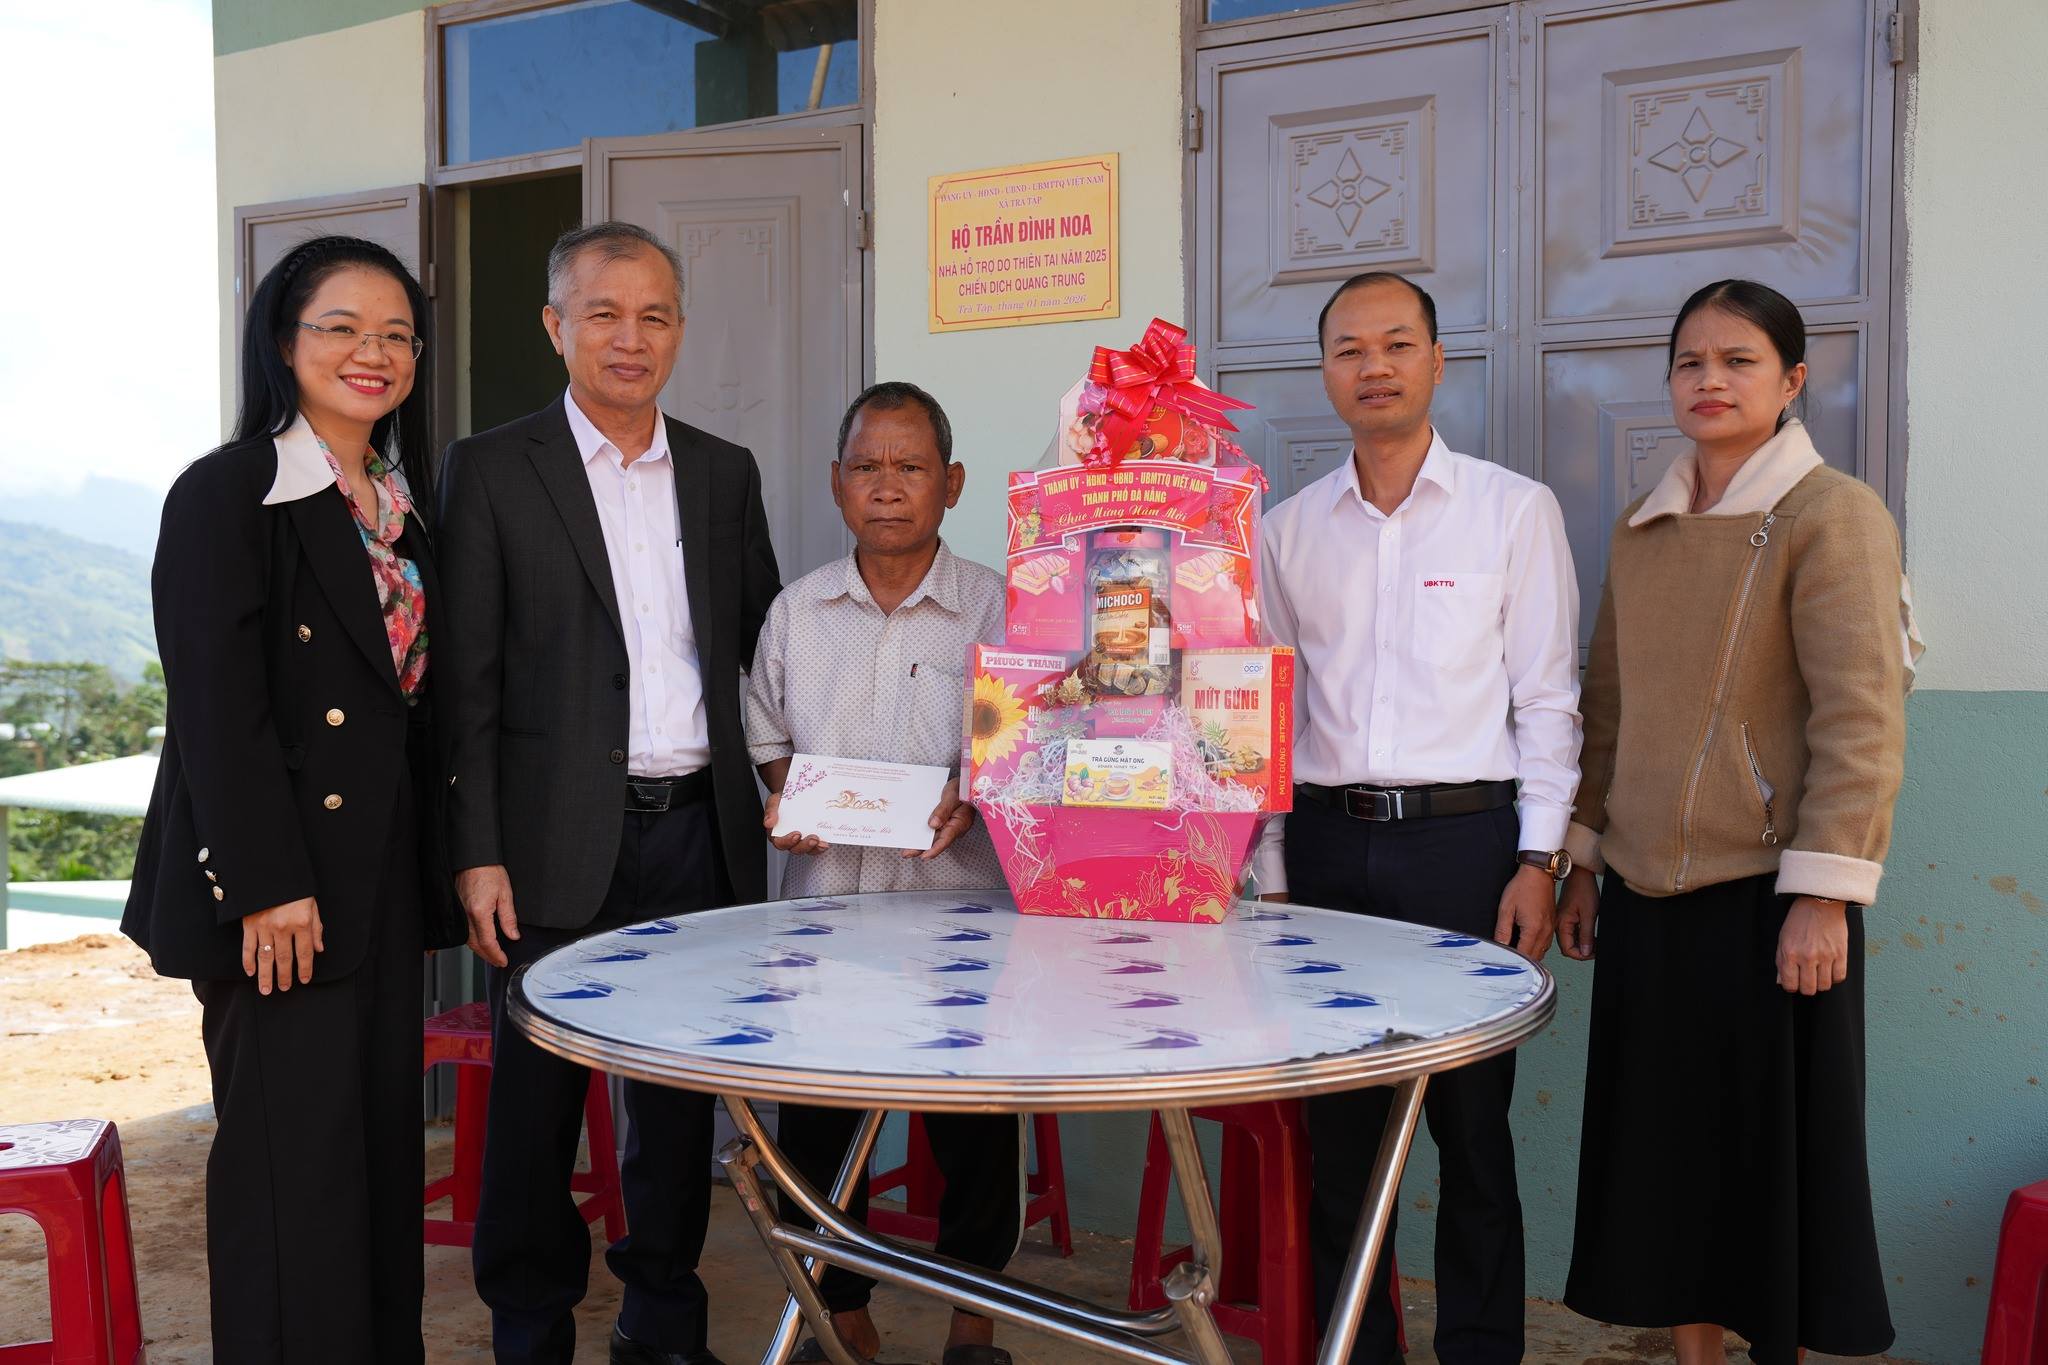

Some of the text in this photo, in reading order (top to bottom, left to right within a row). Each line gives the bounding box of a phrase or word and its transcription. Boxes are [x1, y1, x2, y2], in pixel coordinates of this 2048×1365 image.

[1086, 175, 1104, 185] NAM
[952, 214, 1092, 253] HỘ TRẦN ĐÌNH NOA
[997, 258, 1011, 272] DO
[1013, 253, 1041, 270] THIÊN
[1044, 254, 1058, 267] TAI
[1061, 249, 1082, 265] NĂM
[1085, 249, 1107, 263] 2025
[959, 272, 1085, 296] CHIẾN DỊCH QUANG TRUNG
[1027, 298, 1037, 308] 01
[1064, 294, 1087, 305] 2026
[1113, 472, 1134, 484] UBND
[1140, 472, 1171, 487] UBMTTQ
[1190, 478, 1208, 494] NAM
[1096, 592, 1143, 609] MICHOCO
[1243, 664, 1264, 673] OCOP
[1194, 686, 1259, 710] MỨT GỪNG
